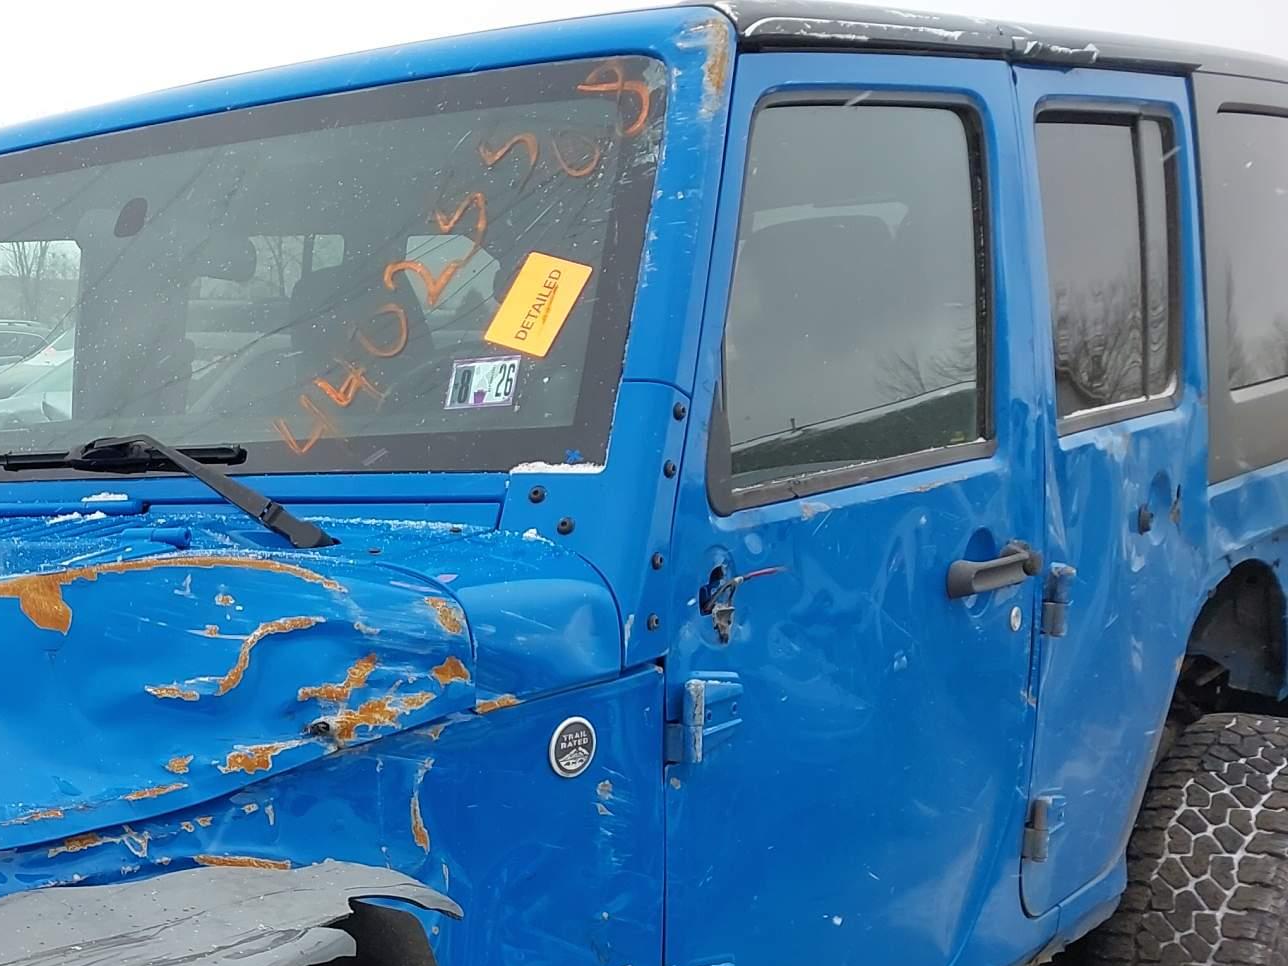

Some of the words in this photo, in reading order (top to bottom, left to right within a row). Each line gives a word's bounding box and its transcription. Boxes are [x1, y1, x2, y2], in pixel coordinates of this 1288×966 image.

[514, 269, 562, 341] DETAILED
[495, 363, 516, 398] 26
[560, 738, 589, 750] RATED
[562, 731, 588, 742] TRAIL
